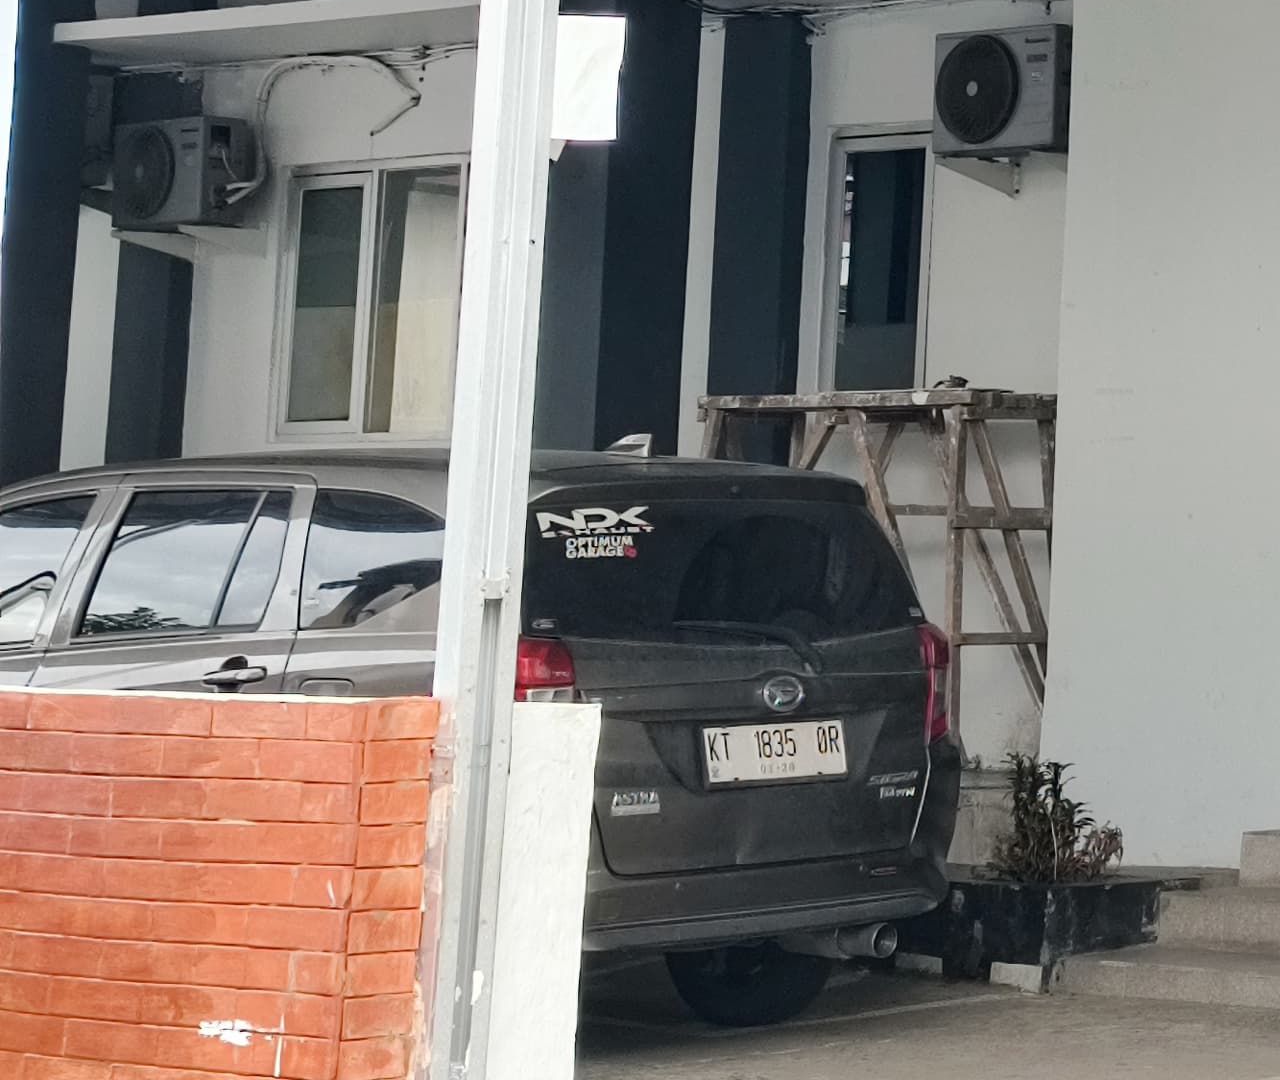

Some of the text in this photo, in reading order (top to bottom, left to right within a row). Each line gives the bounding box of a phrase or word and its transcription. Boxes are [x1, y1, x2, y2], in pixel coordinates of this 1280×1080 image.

[566, 536, 634, 549] OPTIMUM
[566, 546, 625, 558] GARAGE
[708, 732, 730, 762] KT
[754, 728, 797, 759] 1835
